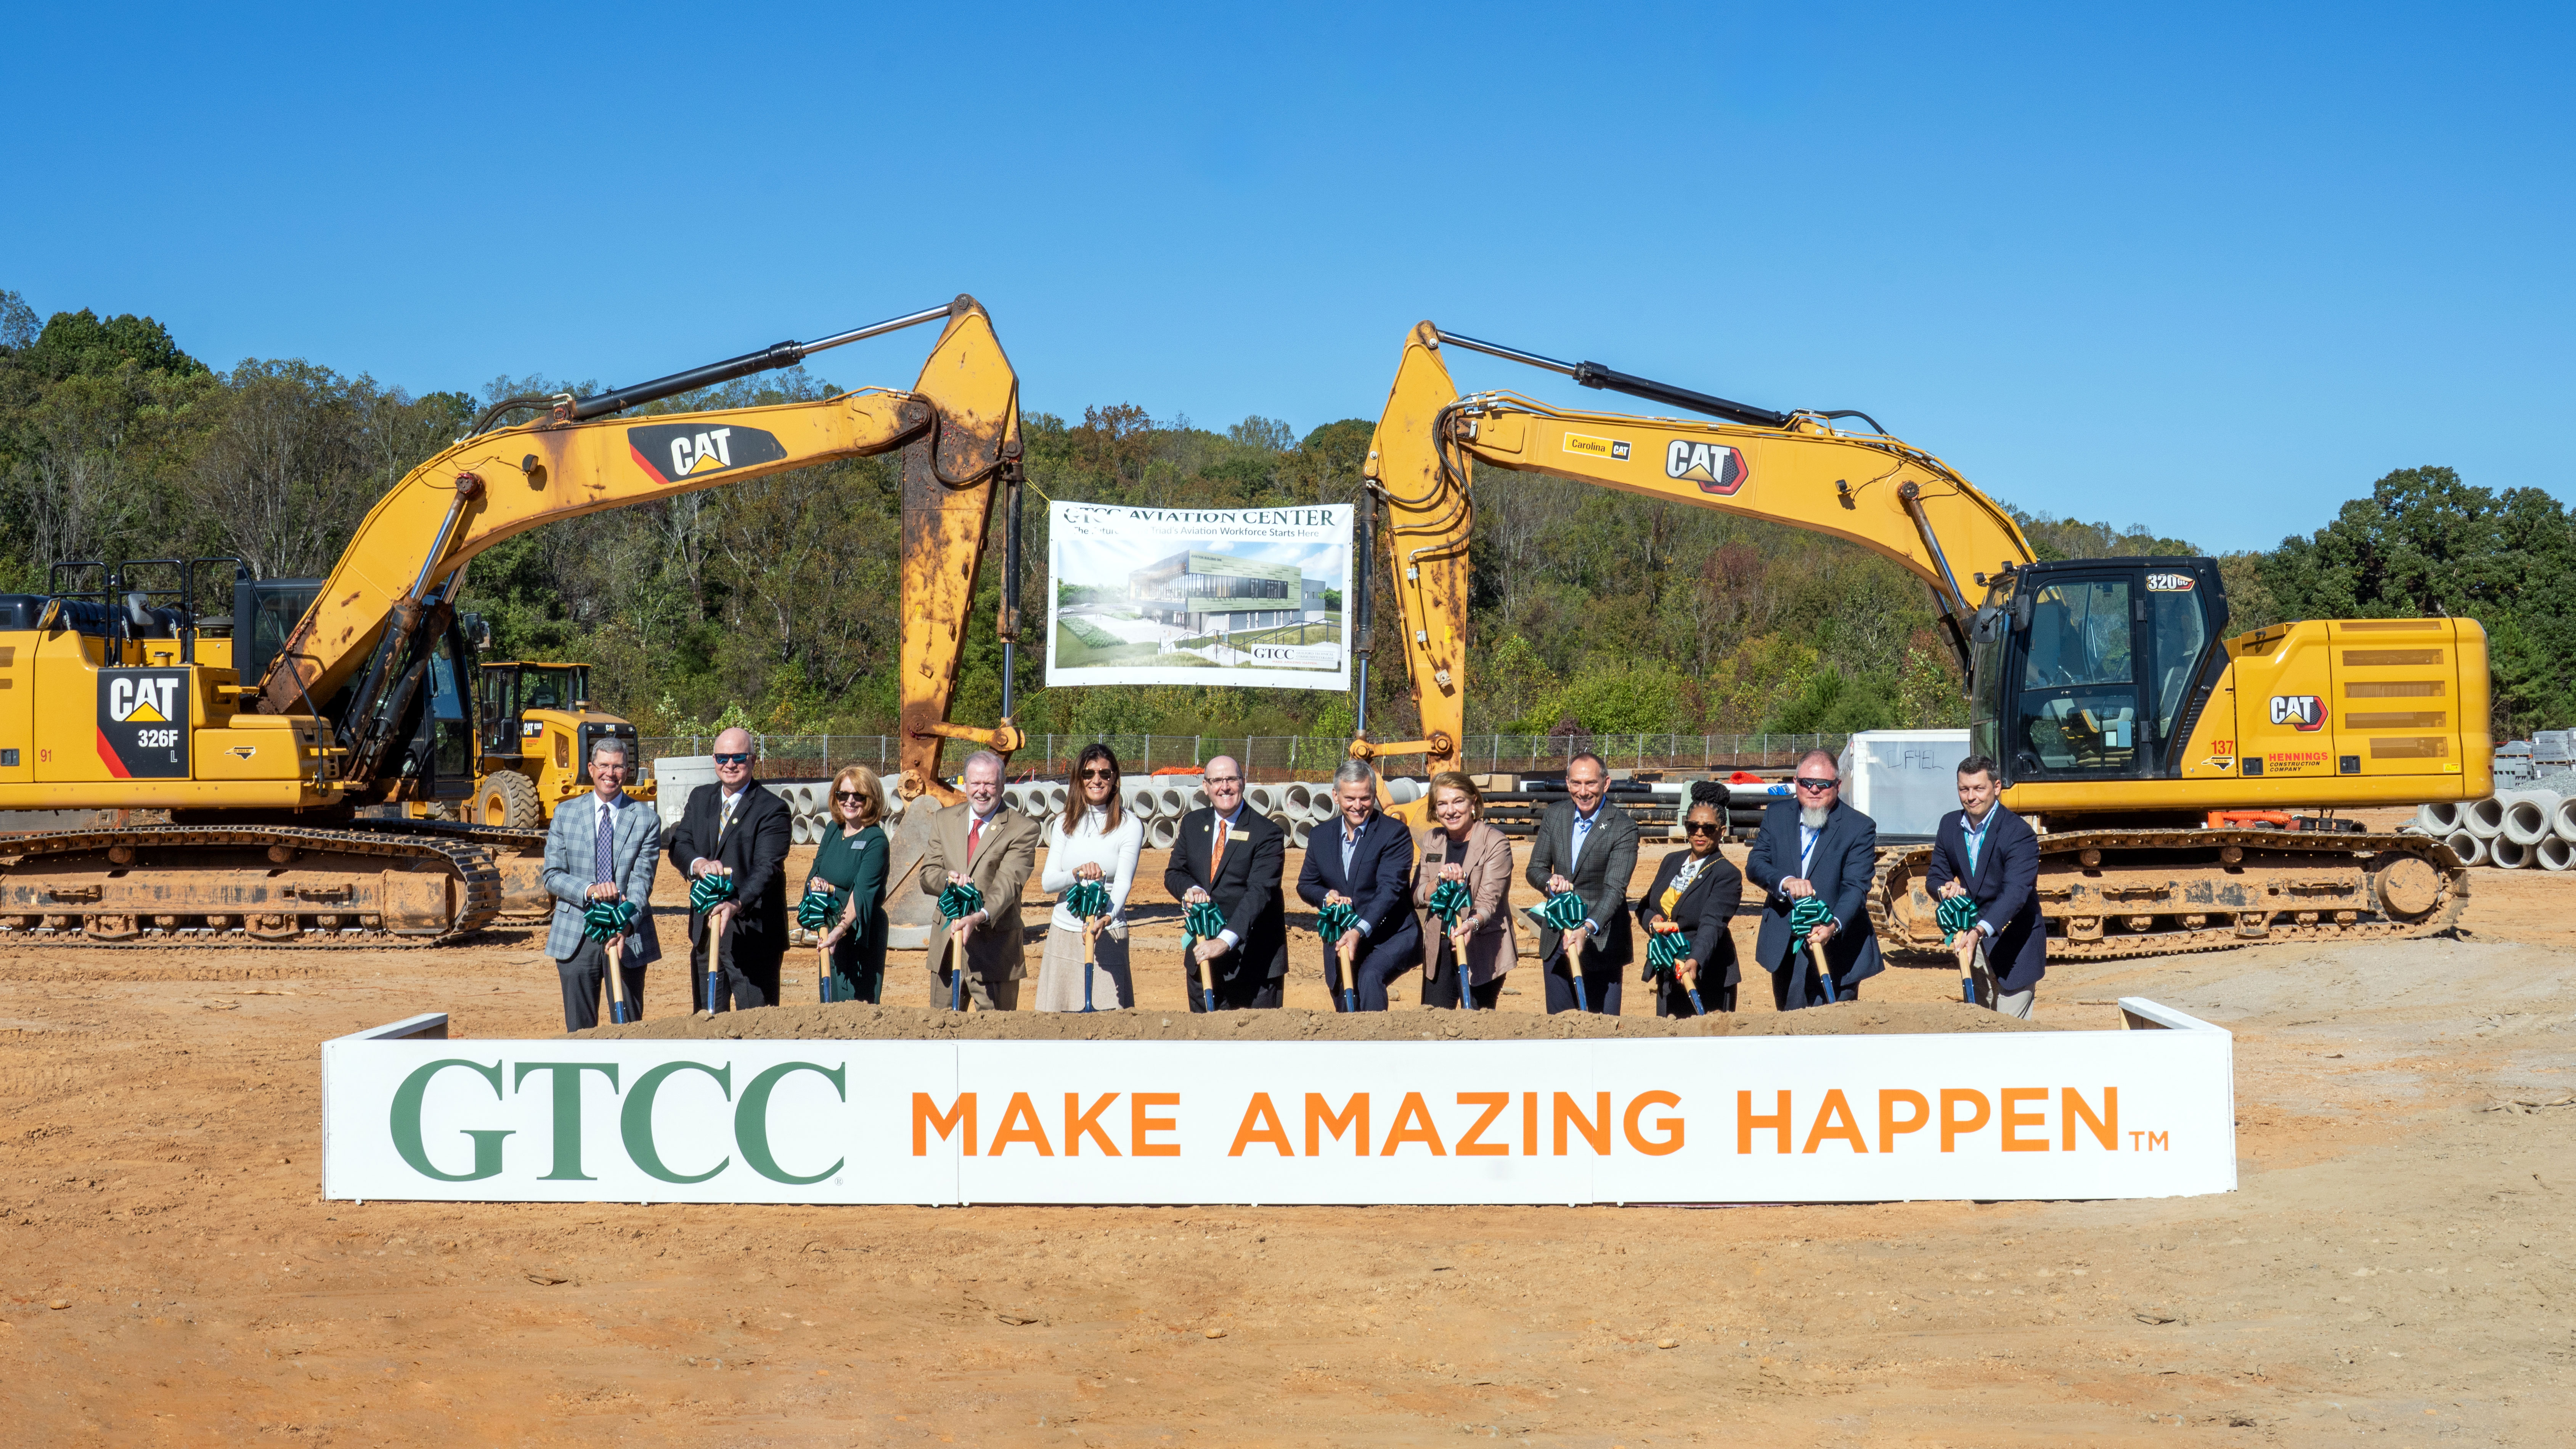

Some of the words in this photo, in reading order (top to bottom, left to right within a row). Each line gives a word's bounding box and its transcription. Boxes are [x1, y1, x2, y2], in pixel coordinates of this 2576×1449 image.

[671, 428, 731, 476] CAT
[1572, 439, 1606, 452] Carolina
[1613, 445, 1628, 456] CAT
[1667, 440, 1730, 483] CAT
[1129, 510, 1238, 523] AVIATION
[1243, 510, 1335, 526] CENTER
[1151, 526, 1178, 534] Triad's
[1180, 526, 1217, 534] Aviation
[1220, 527, 1267, 536] Workforce
[1270, 528, 1295, 537] Starts
[2148, 574, 2177, 589] 320
[1254, 648, 1294, 660] GTCC
[110, 678, 178, 722] CAT
[2271, 696, 2314, 724] CAT
[524, 723, 533, 735] CAT
[138, 729, 178, 747] 326F
[2211, 740, 2234, 754] 137
[40, 749, 51, 762] 91
[171, 750, 177, 762] L
[2269, 752, 2328, 761] HENNINGS
[390, 1059, 846, 1185] GTCC
[912, 1092, 1181, 1156] MAKE
[1228, 1090, 1685, 1156] AMAZING
